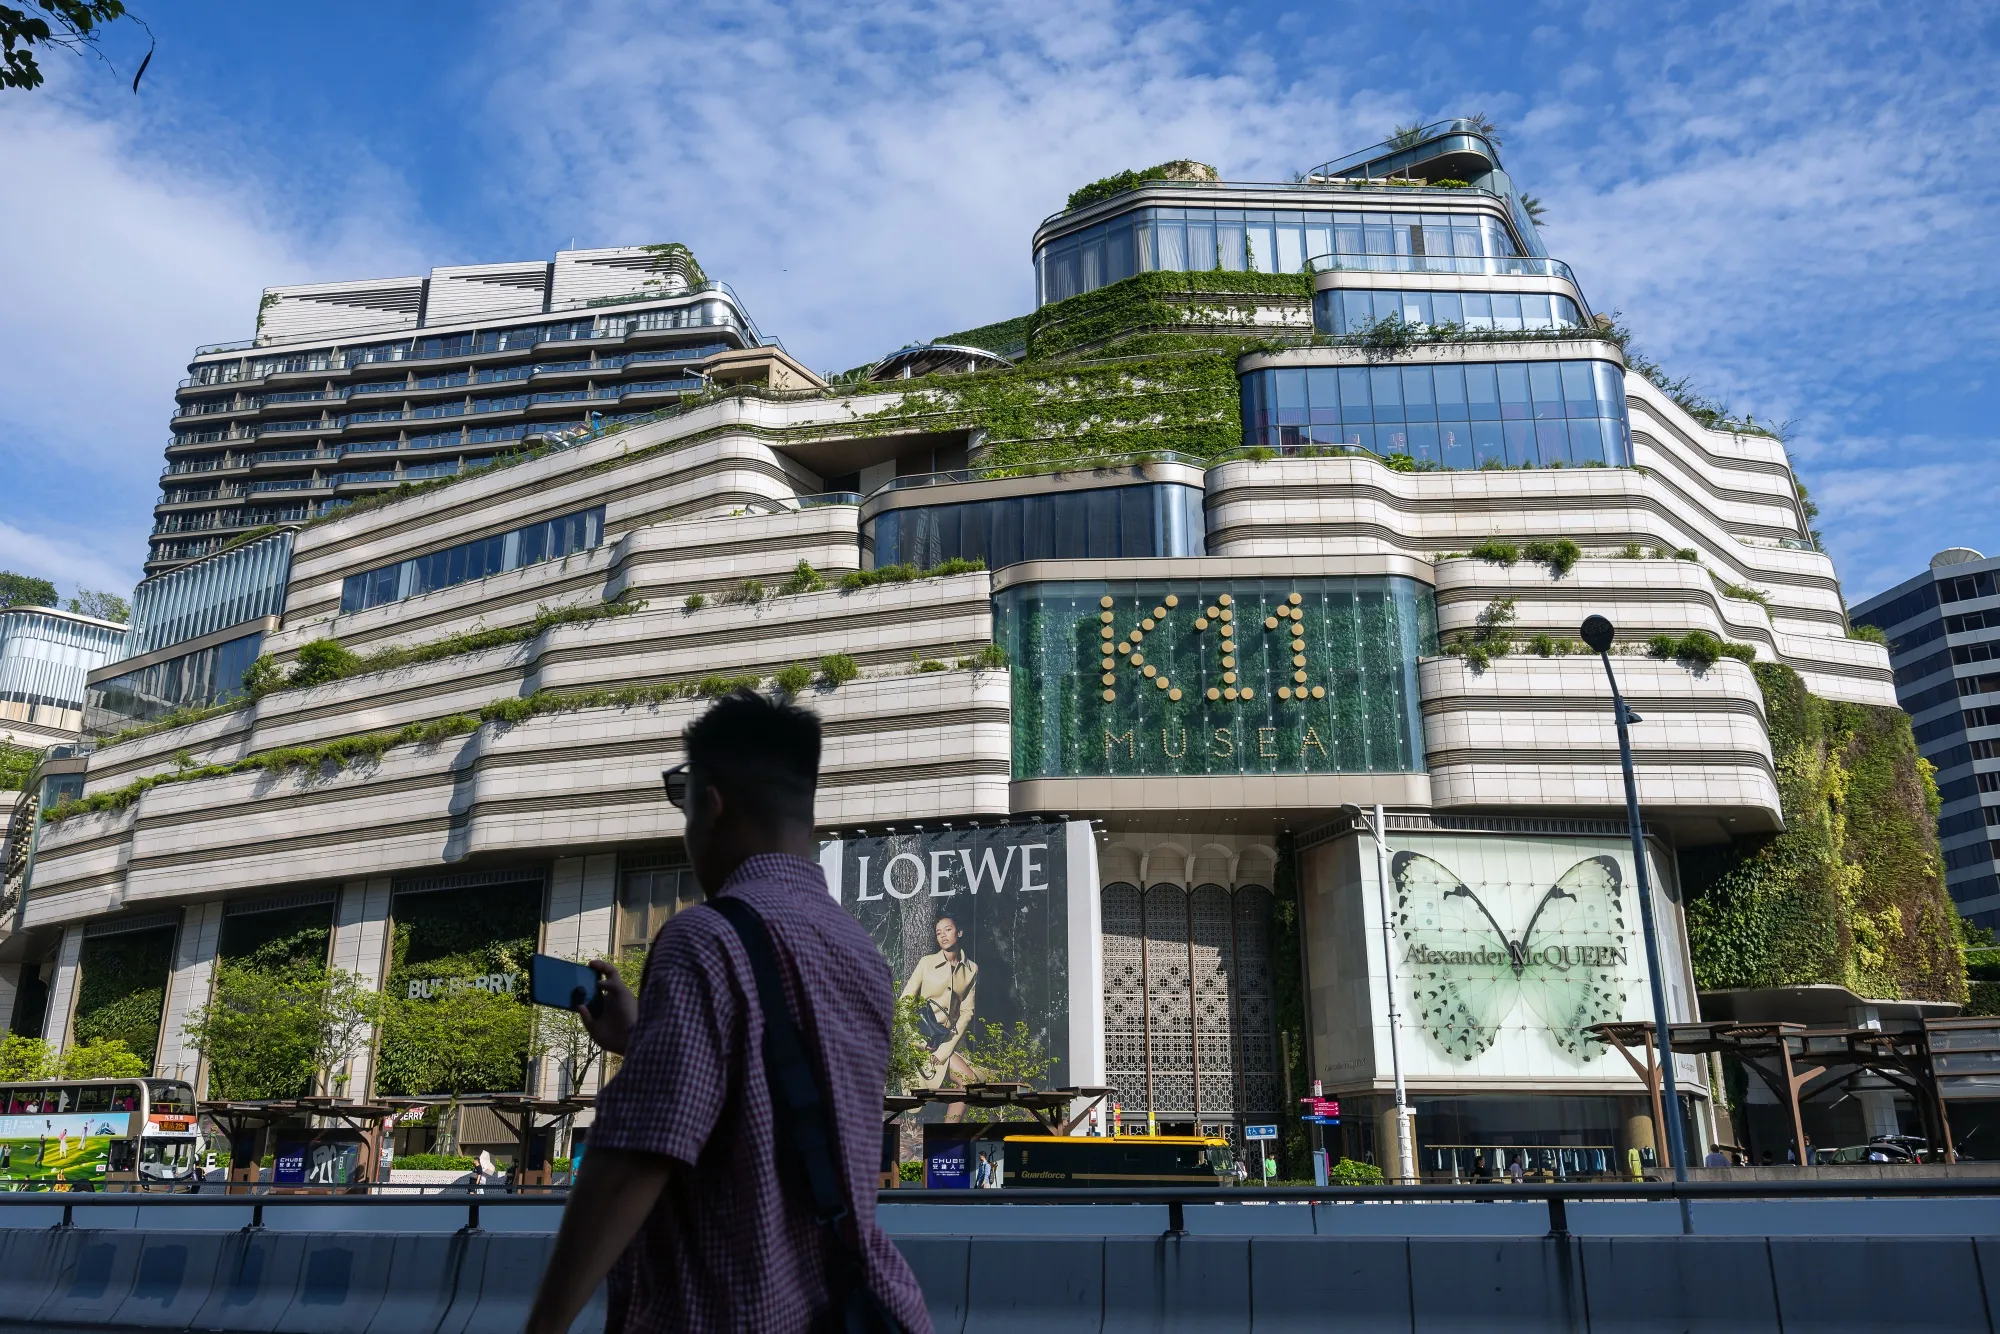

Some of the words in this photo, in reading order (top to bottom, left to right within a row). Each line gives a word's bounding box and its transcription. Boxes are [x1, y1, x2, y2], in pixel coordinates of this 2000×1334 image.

[1100, 592, 1325, 702] K11
[1105, 726, 1327, 759] MUSEA
[856, 843, 1049, 902] LOEWE
[1403, 943, 1507, 965] Alexander
[1510, 944, 1628, 973] McQUEEN
[1021, 1170, 1066, 1178] Guardforce
